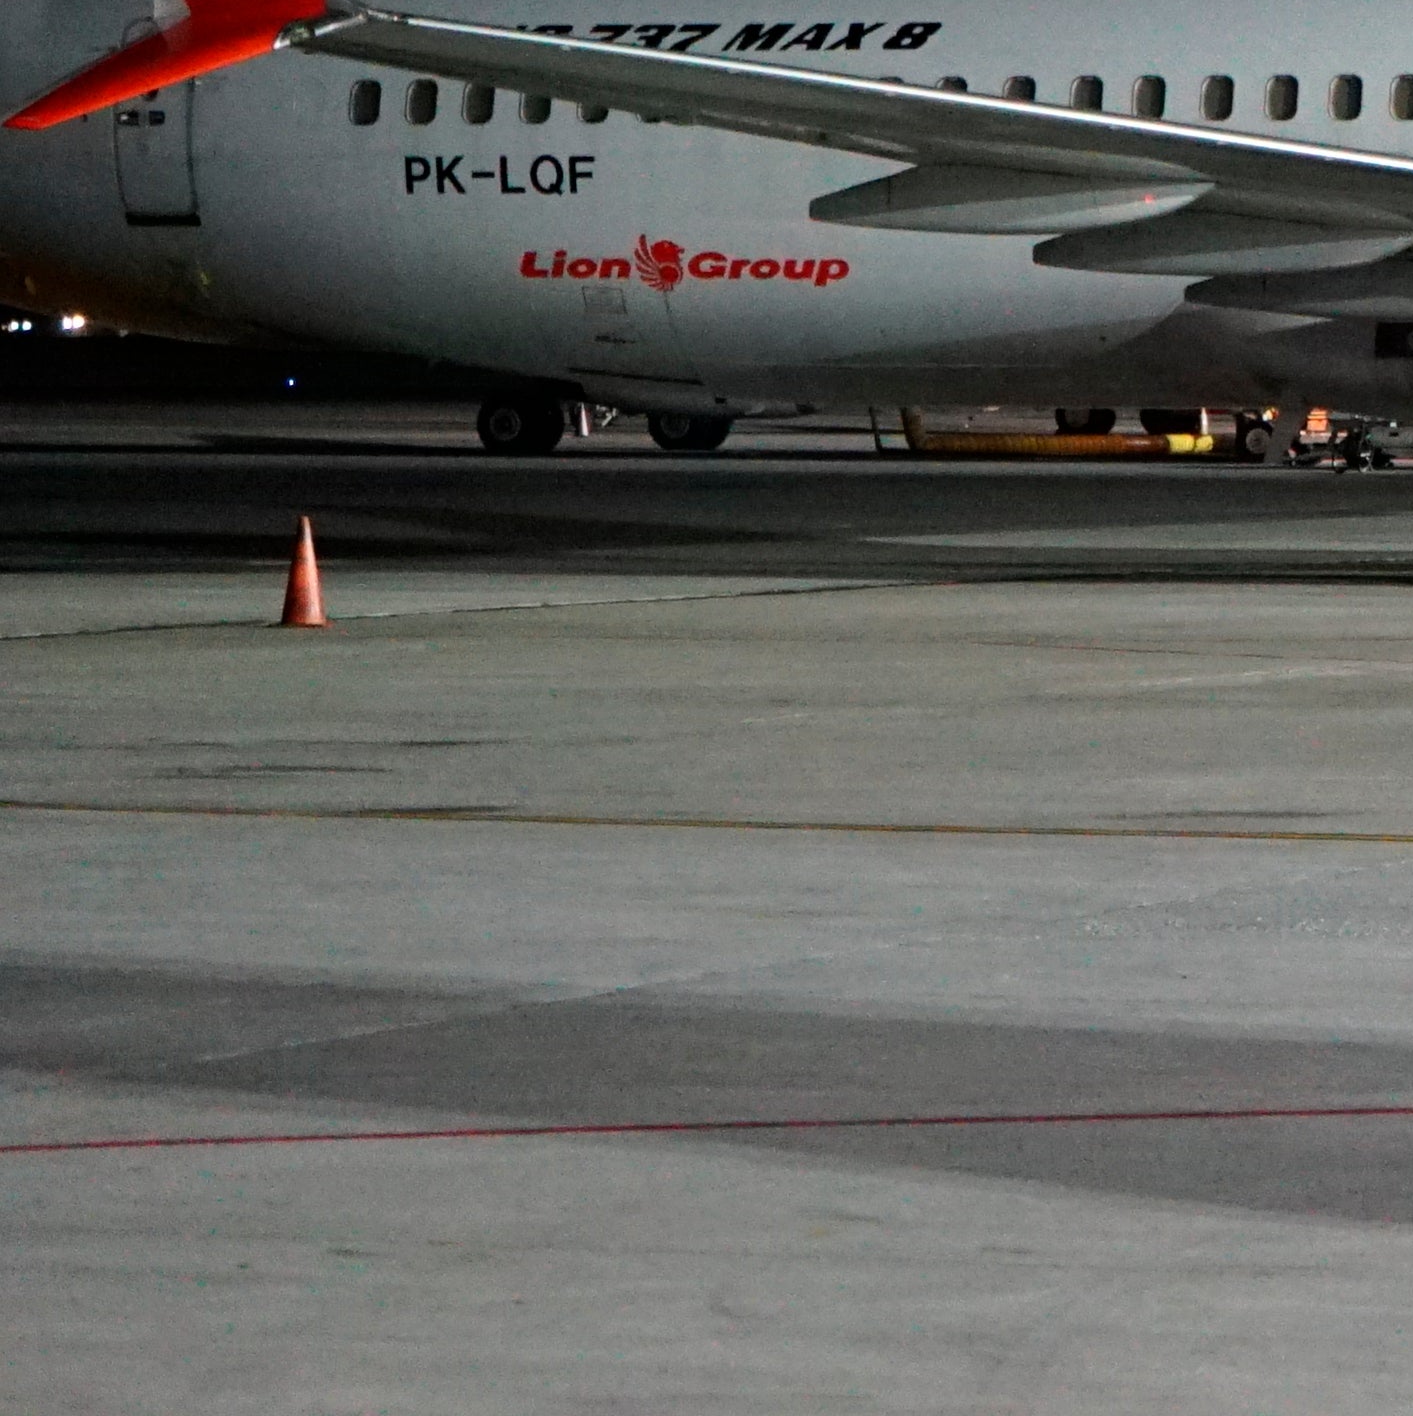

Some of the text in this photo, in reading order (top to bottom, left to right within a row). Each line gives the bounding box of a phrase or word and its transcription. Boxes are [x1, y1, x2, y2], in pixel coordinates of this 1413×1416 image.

[720, 22, 886, 52] MAX
[882, 22, 942, 51] 8
[404, 154, 596, 197] PK-LQF
[518, 249, 850, 288] Lion Group
